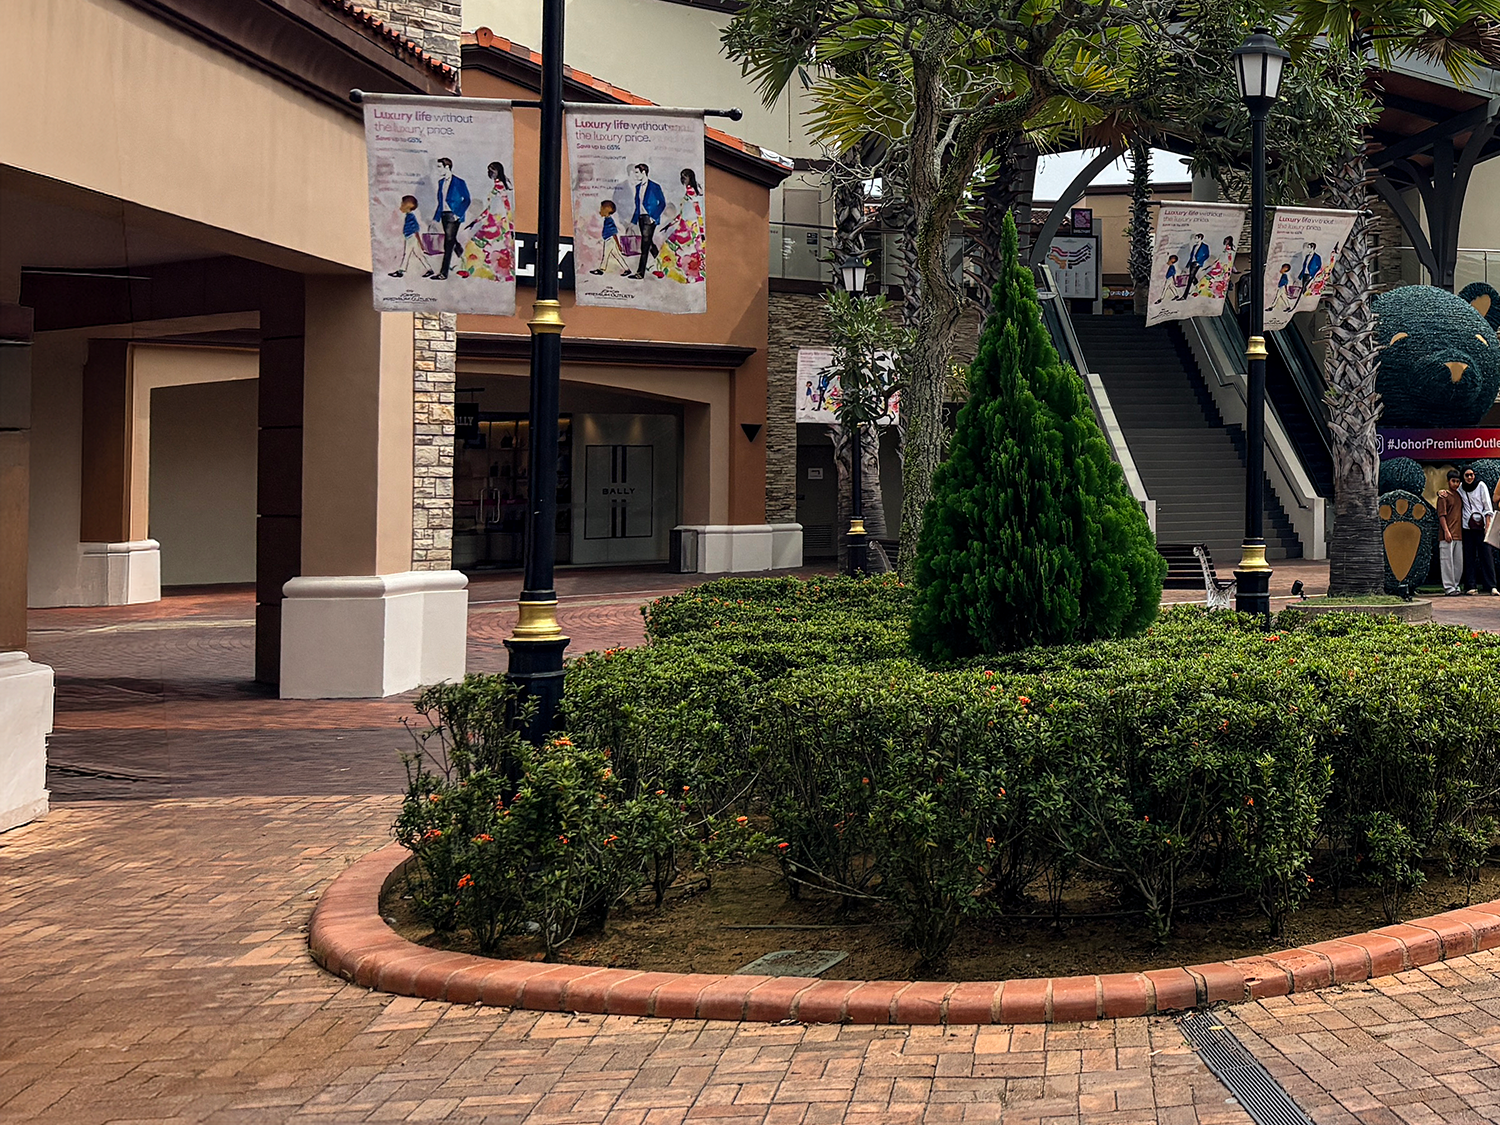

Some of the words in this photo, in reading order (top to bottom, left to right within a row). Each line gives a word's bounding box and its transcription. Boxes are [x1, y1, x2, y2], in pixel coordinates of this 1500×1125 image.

[373, 108, 413, 123] Luxury
[415, 110, 432, 122] life
[434, 113, 474, 124] without
[374, 122, 392, 132] the
[393, 123, 425, 136] luxury
[575, 118, 611, 131] Luxury
[614, 119, 629, 130] life
[631, 121, 668, 131] without
[575, 130, 591, 140] the
[593, 131, 623, 144] luxury
[624, 133, 651, 143] price.
[576, 142, 591, 150] Save
[602, 487, 635, 495] BALLY
